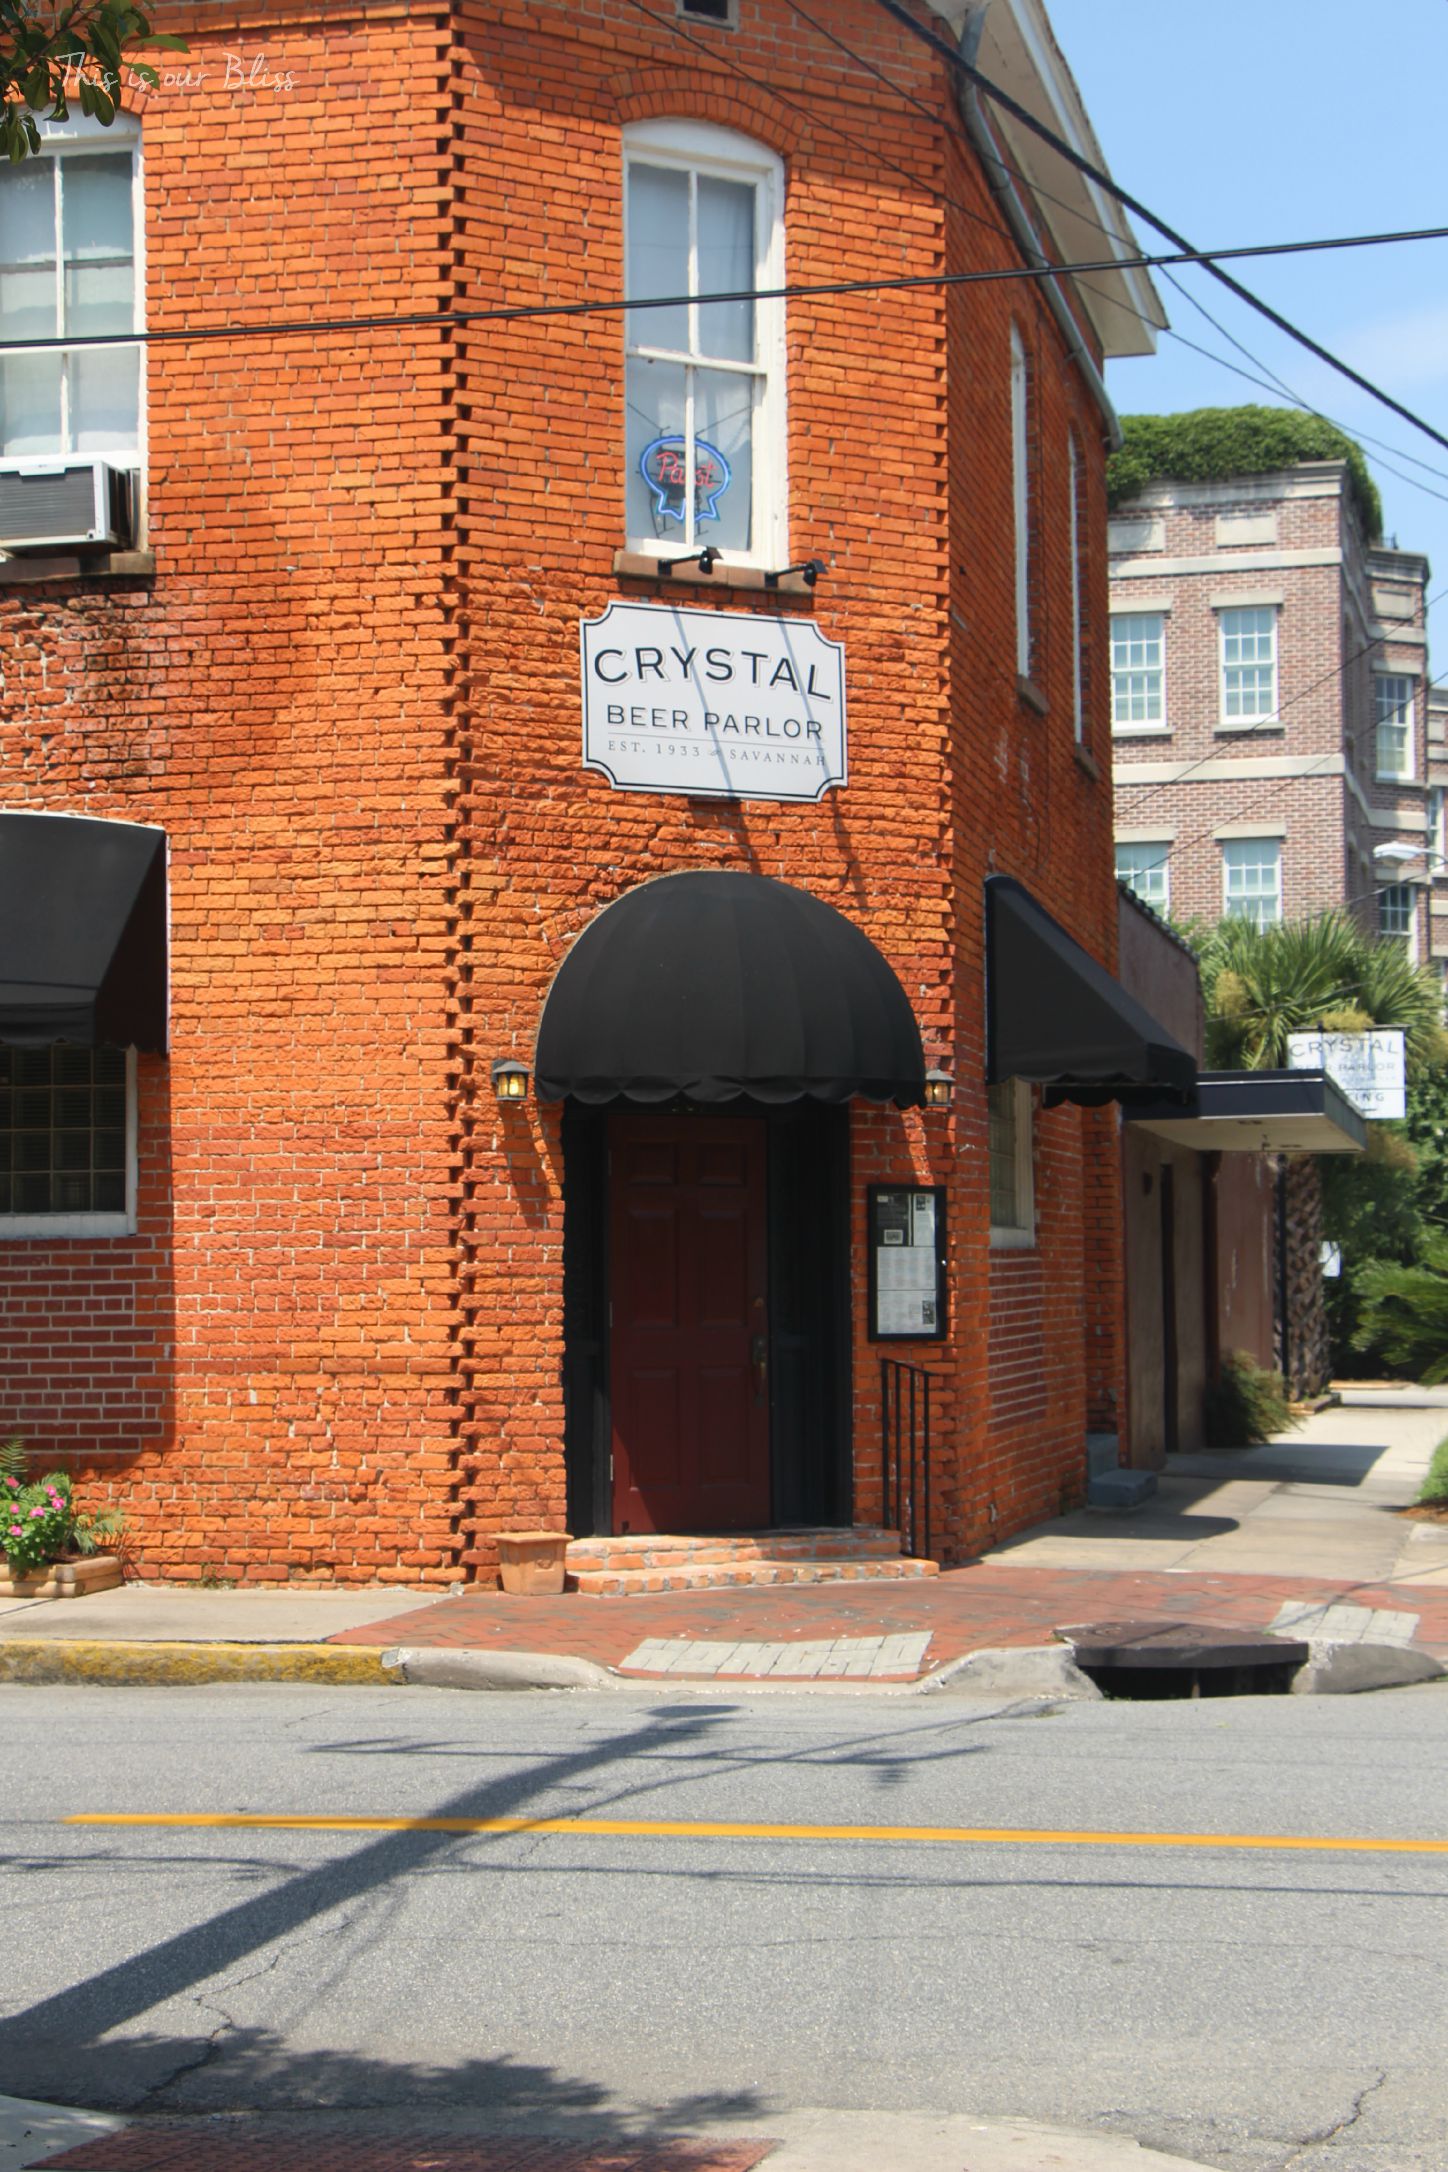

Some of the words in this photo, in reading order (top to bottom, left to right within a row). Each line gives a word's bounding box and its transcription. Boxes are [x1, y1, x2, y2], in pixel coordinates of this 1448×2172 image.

[656, 452, 716, 488] Past
[594, 646, 833, 703] CRYSTAL
[606, 704, 689, 730] BEER
[704, 712, 823, 740] PARLOR
[608, 740, 647, 754] EST.
[656, 743, 701, 757] 1933
[729, 749, 827, 767] SAVANNAH
[1289, 1037, 1399, 1058] CRYSTAL
